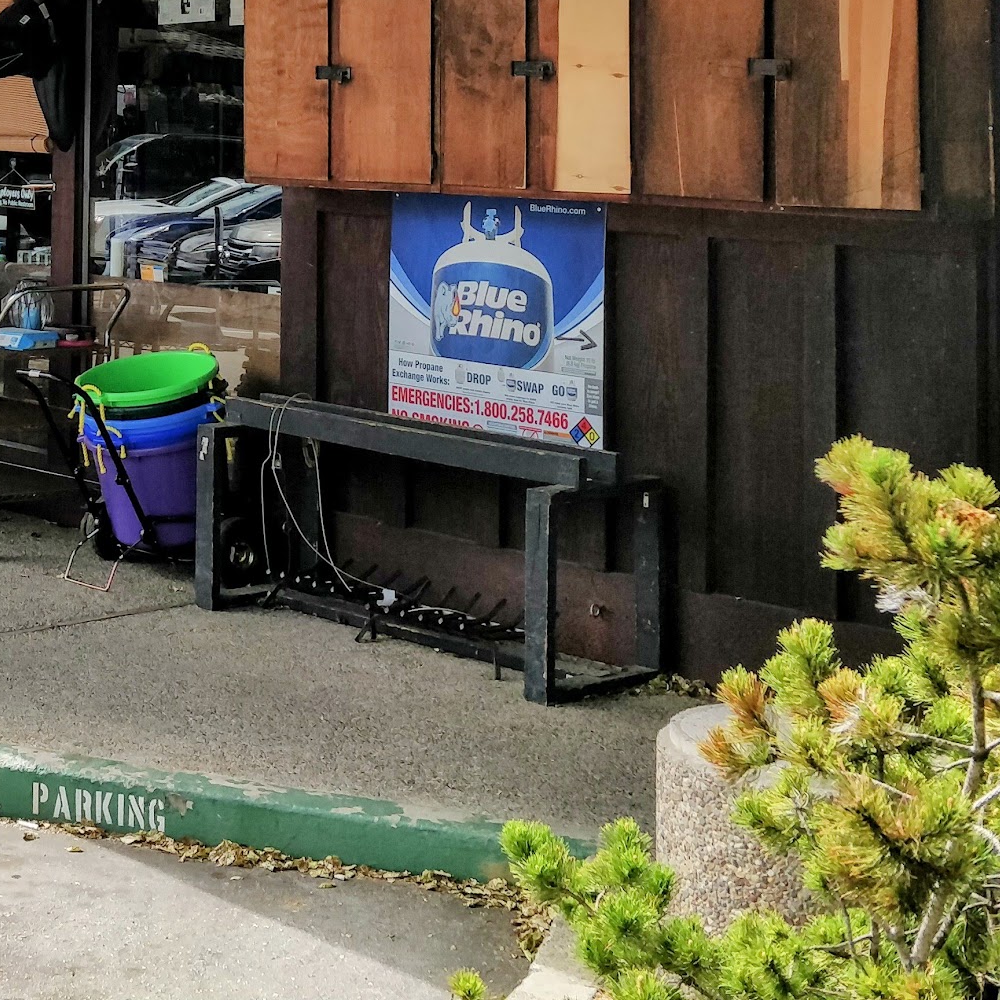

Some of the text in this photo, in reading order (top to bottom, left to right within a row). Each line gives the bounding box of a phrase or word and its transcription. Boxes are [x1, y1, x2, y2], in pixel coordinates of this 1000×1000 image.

[529, 203, 586, 216] BlueRhino.com
[457, 280, 528, 313] Blue
[449, 308, 541, 346] Rhino
[398, 357, 443, 372] How Propane
[392, 368, 450, 385] Exchange Works:
[466, 372, 491, 385] DROP
[516, 381, 544, 395] SWAP
[552, 384, 565, 397] GO
[32, 782, 165, 832] PARKING
